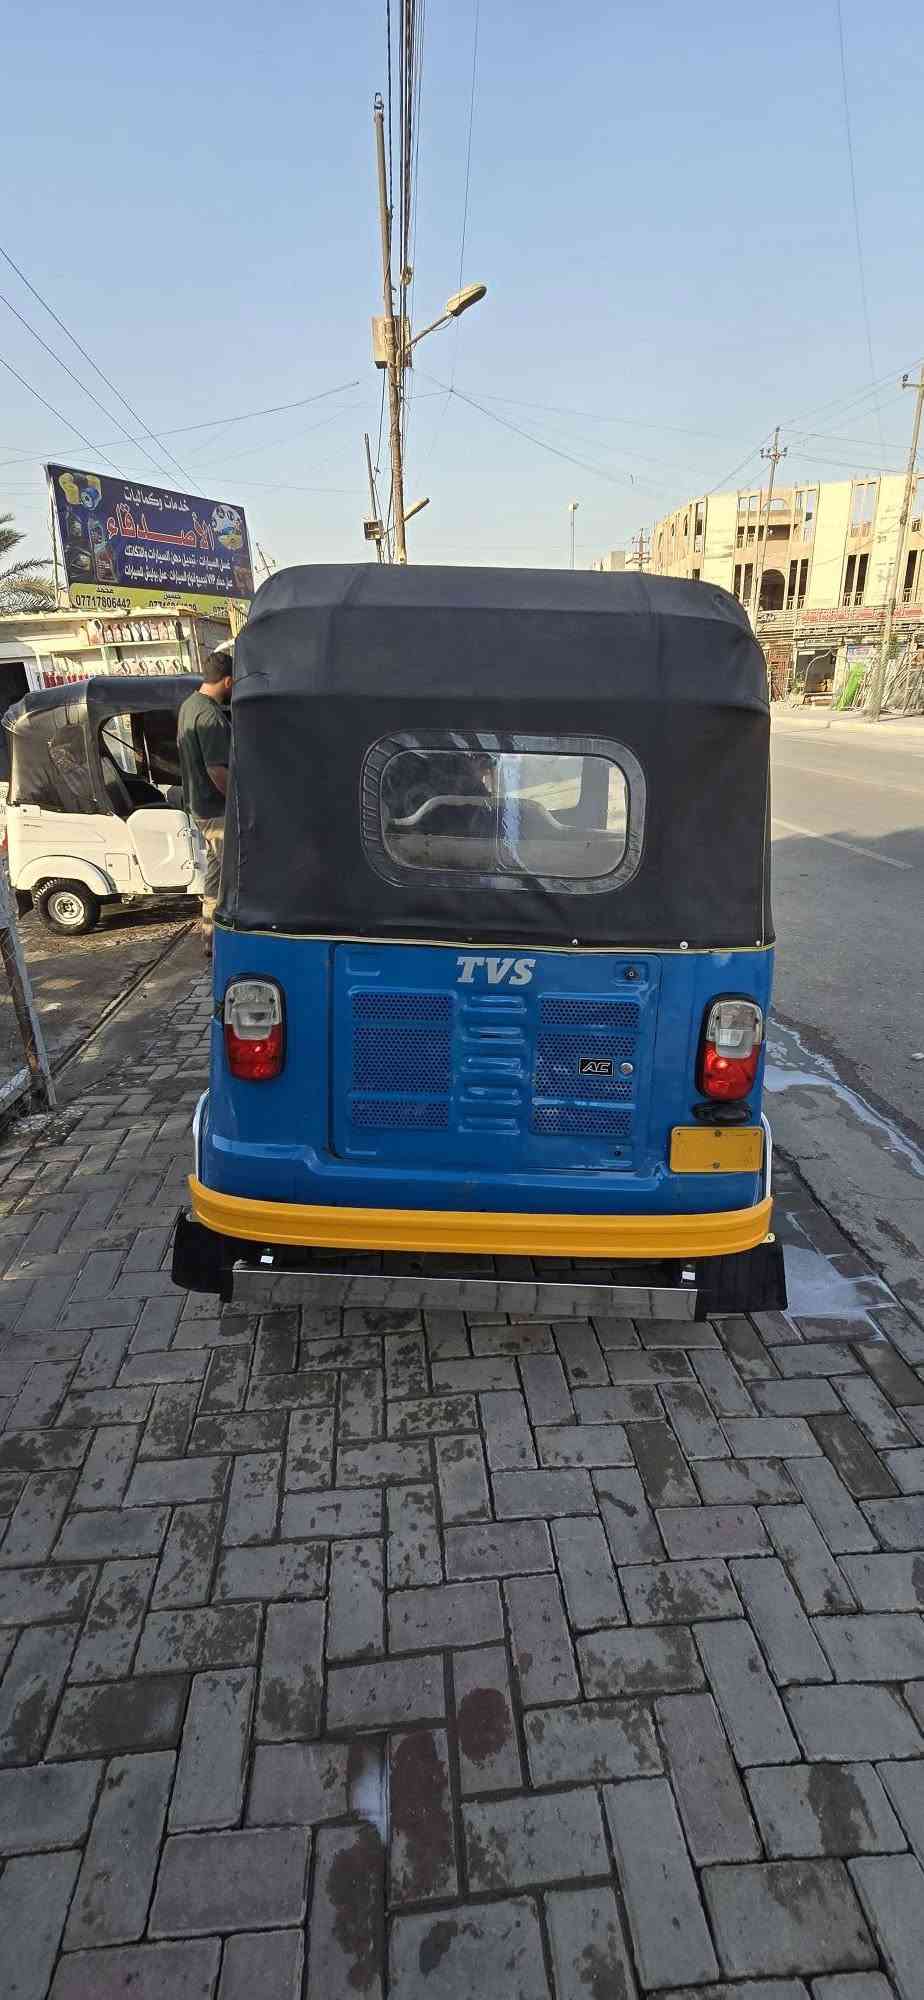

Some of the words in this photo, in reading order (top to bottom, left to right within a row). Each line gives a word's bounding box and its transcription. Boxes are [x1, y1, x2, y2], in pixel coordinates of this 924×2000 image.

[124, 487, 163, 510] وكماليات
[165, 495, 190, 512] خدمات
[456, 956, 537, 986] TVS
